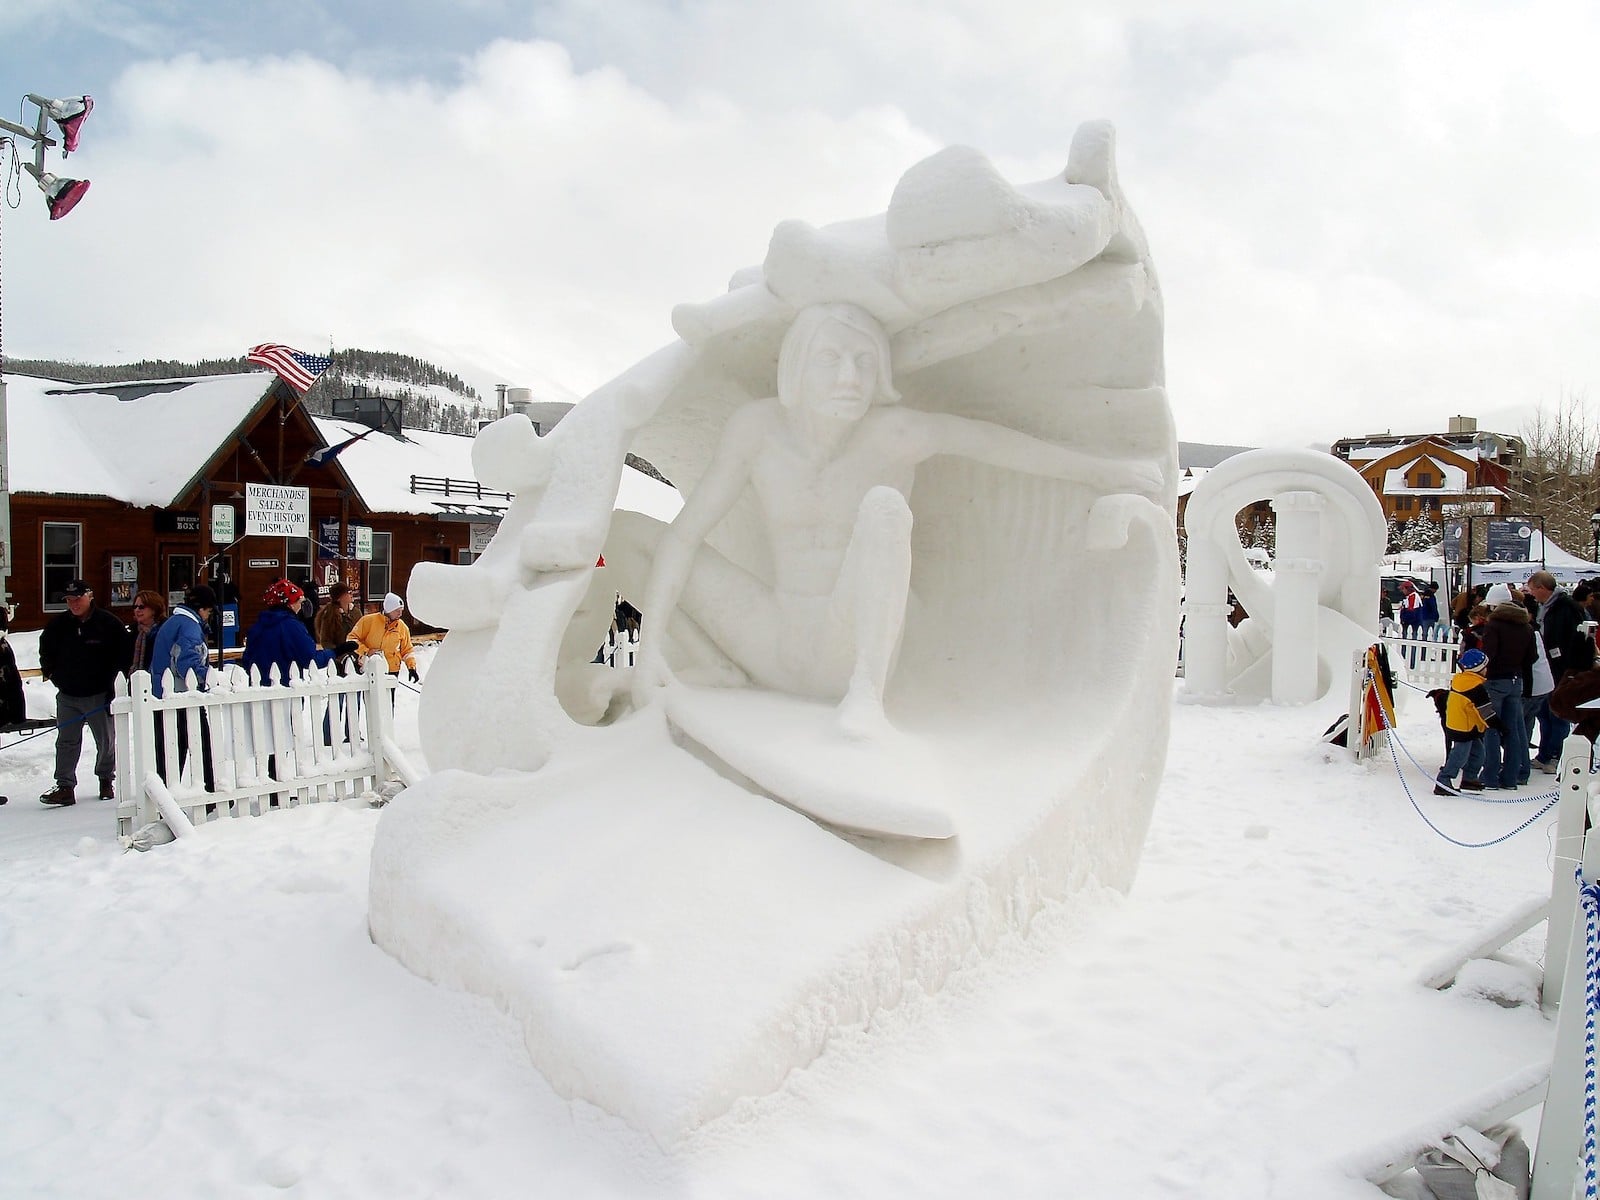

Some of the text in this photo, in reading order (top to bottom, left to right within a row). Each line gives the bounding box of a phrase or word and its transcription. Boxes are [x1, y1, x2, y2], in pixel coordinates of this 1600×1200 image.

[248, 486, 307, 500] MERCHANDISE
[258, 499, 294, 511] SALES &
[248, 510, 306, 523] EVENT HISTORY
[177, 522, 195, 530] BOX
[215, 520, 231, 528] MINUTE
[259, 523, 294, 534] DISPLAY
